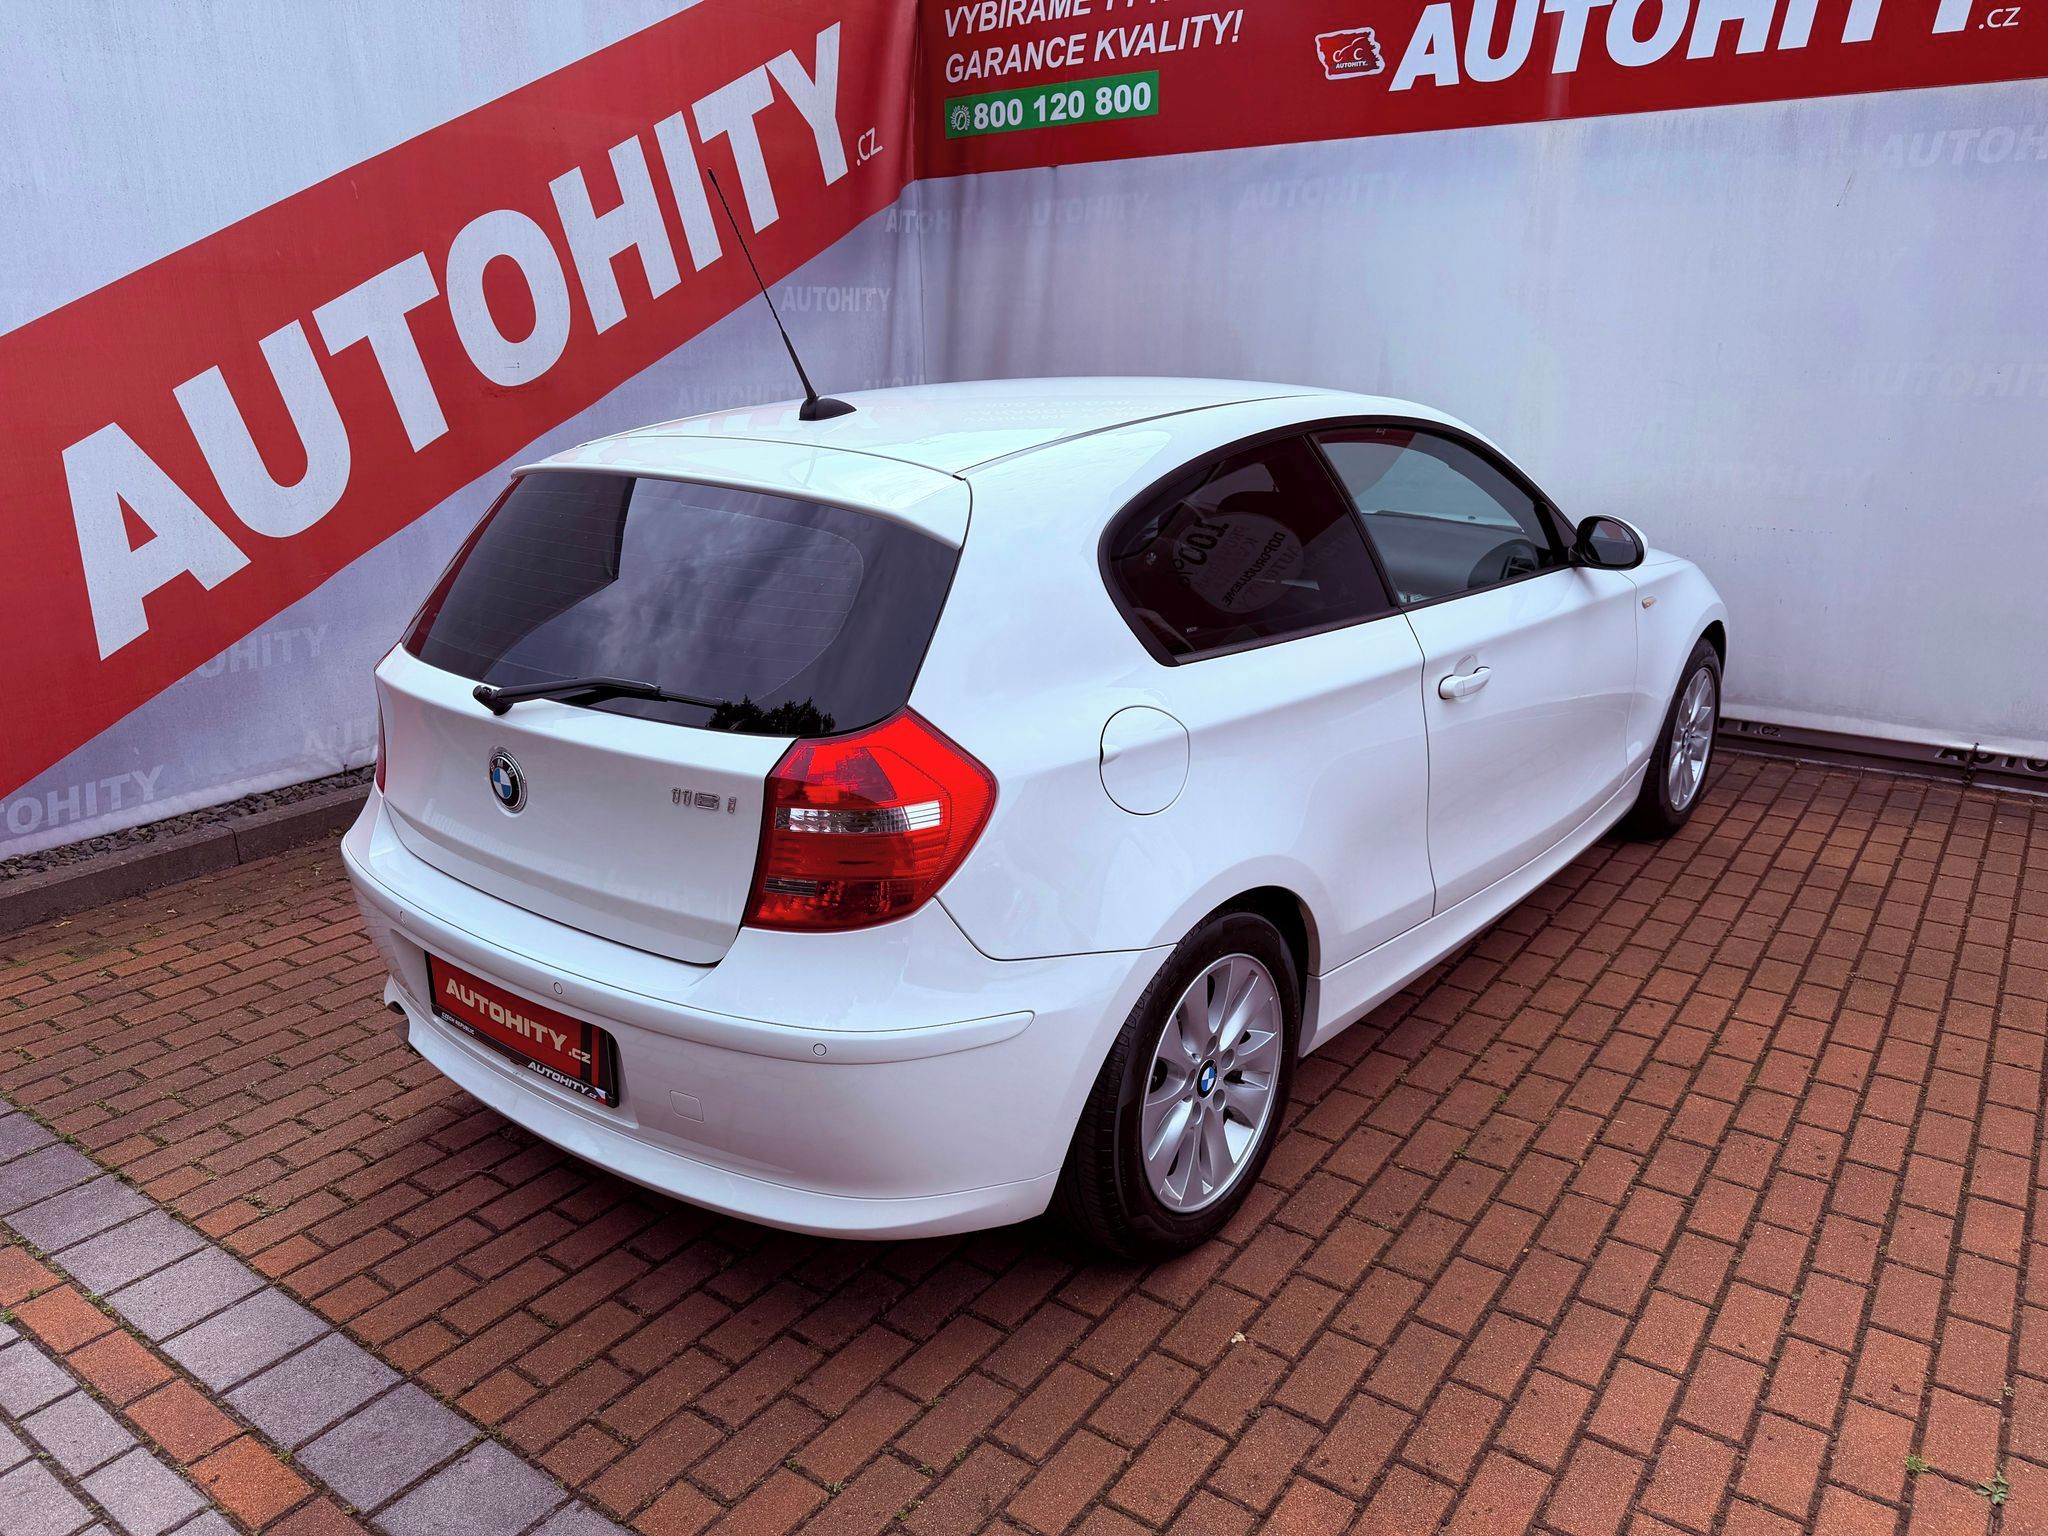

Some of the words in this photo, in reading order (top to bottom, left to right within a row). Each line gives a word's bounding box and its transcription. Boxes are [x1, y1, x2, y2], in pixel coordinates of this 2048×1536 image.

[945, 33, 1087, 84] GARANCE
[1094, 9, 1244, 62] KVALITY!
[973, 98, 1023, 130] 800
[1033, 90, 1085, 122] 120
[1095, 82, 1151, 116] 800
[780, 287, 891, 313] AUTOHITY
